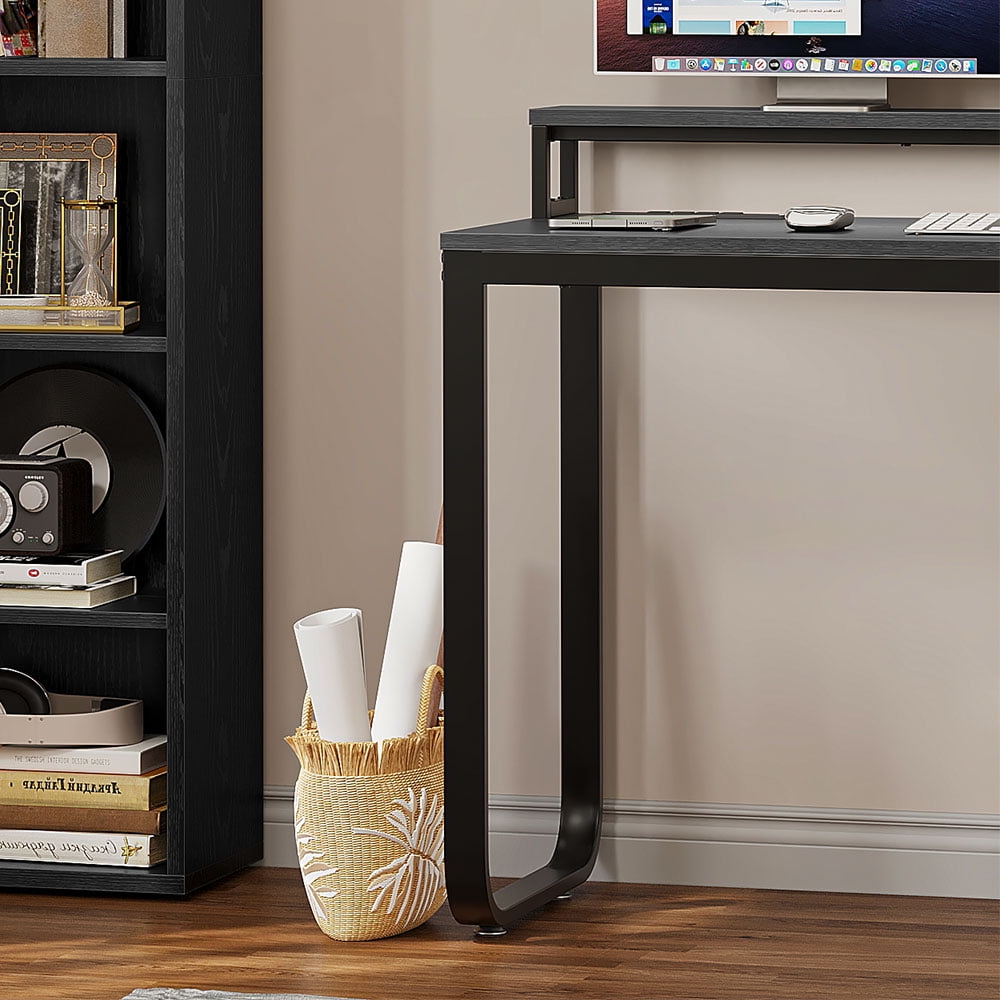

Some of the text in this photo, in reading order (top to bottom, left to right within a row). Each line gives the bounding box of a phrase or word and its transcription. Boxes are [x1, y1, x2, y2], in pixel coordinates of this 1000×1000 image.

[14, 755, 23, 763] THE
[47, 756, 69, 765] INTERIOR
[71, 757, 89, 765] DESIGN
